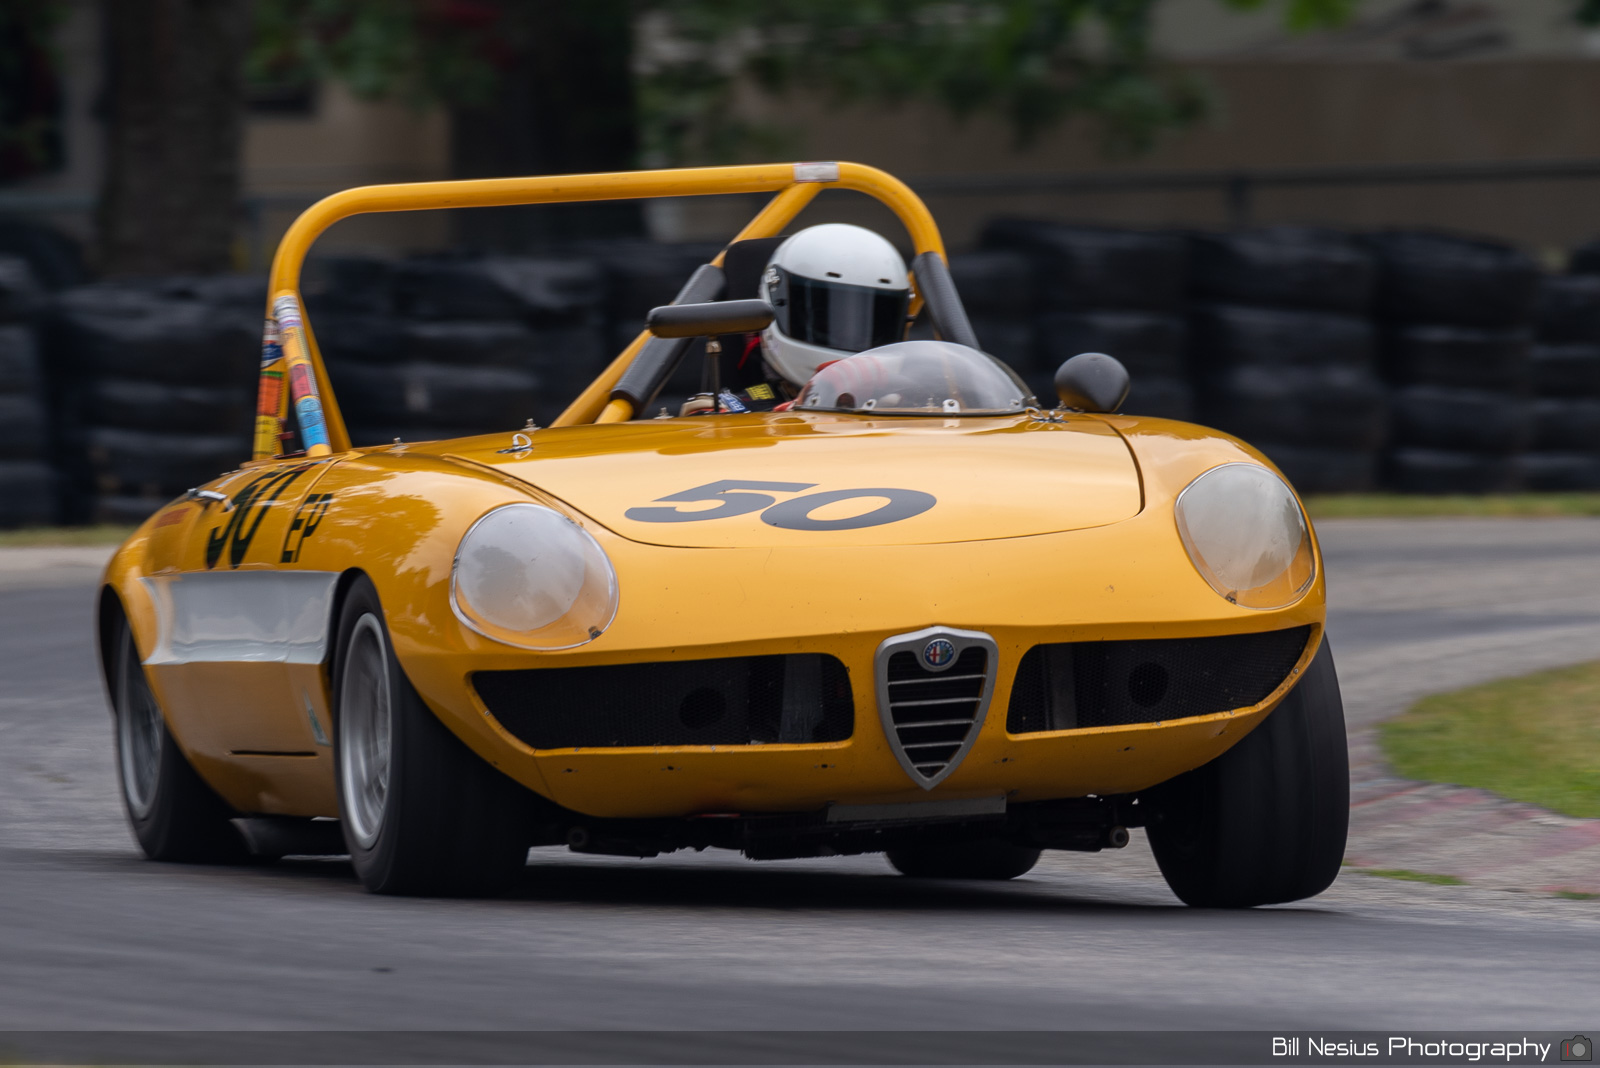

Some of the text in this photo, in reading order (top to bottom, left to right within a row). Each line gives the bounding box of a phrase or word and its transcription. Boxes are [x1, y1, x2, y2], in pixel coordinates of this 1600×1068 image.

[206, 466, 333, 569] 50 EP
[624, 479, 937, 531] 50
